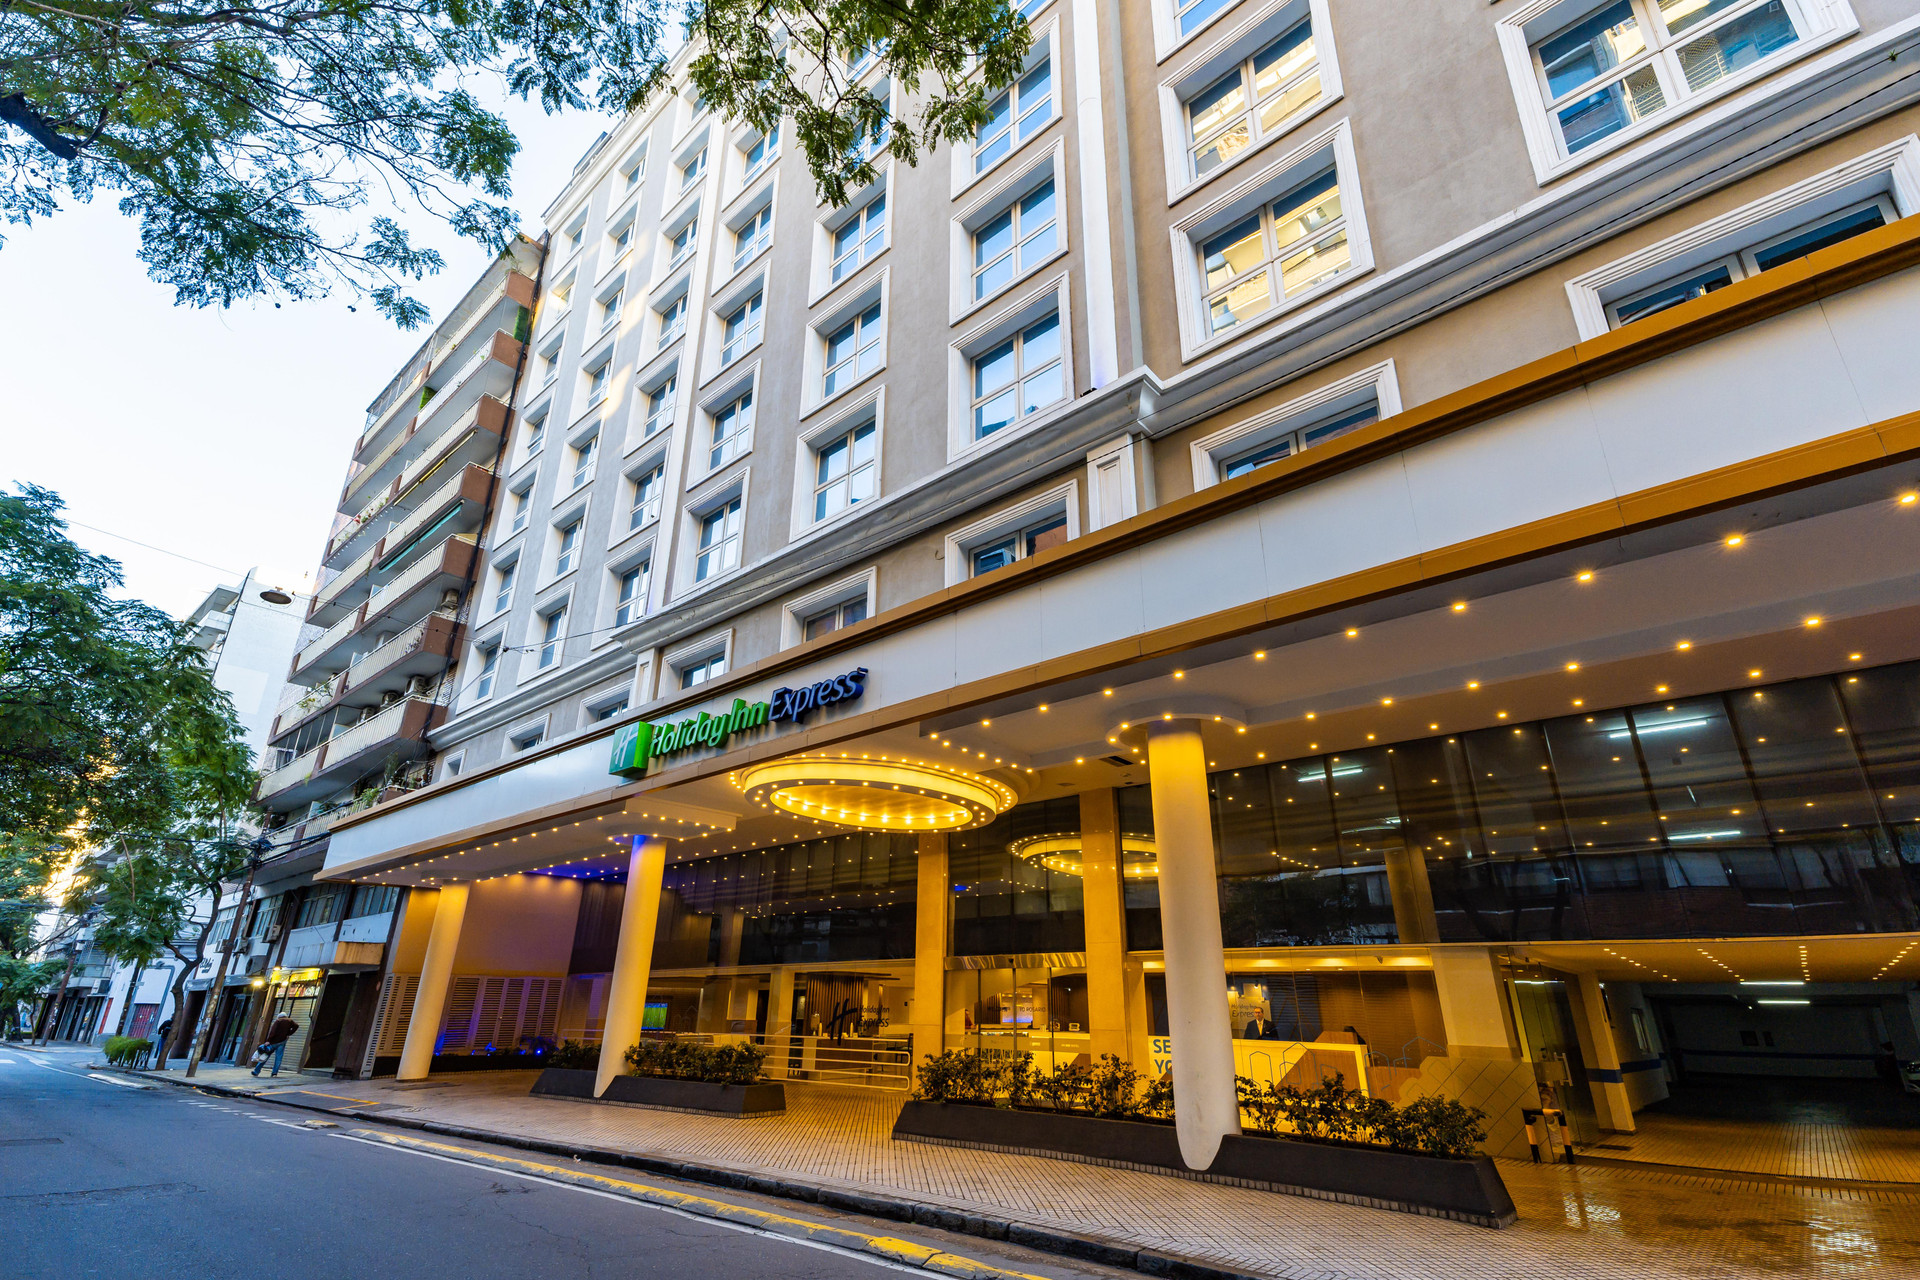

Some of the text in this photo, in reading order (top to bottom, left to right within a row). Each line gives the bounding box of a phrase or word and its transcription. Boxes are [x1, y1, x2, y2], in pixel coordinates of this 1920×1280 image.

[648, 711, 731, 758] Holiday
[727, 698, 769, 734] Inn
[768, 670, 865, 723] Express
[858, 1015, 889, 1030] Express
